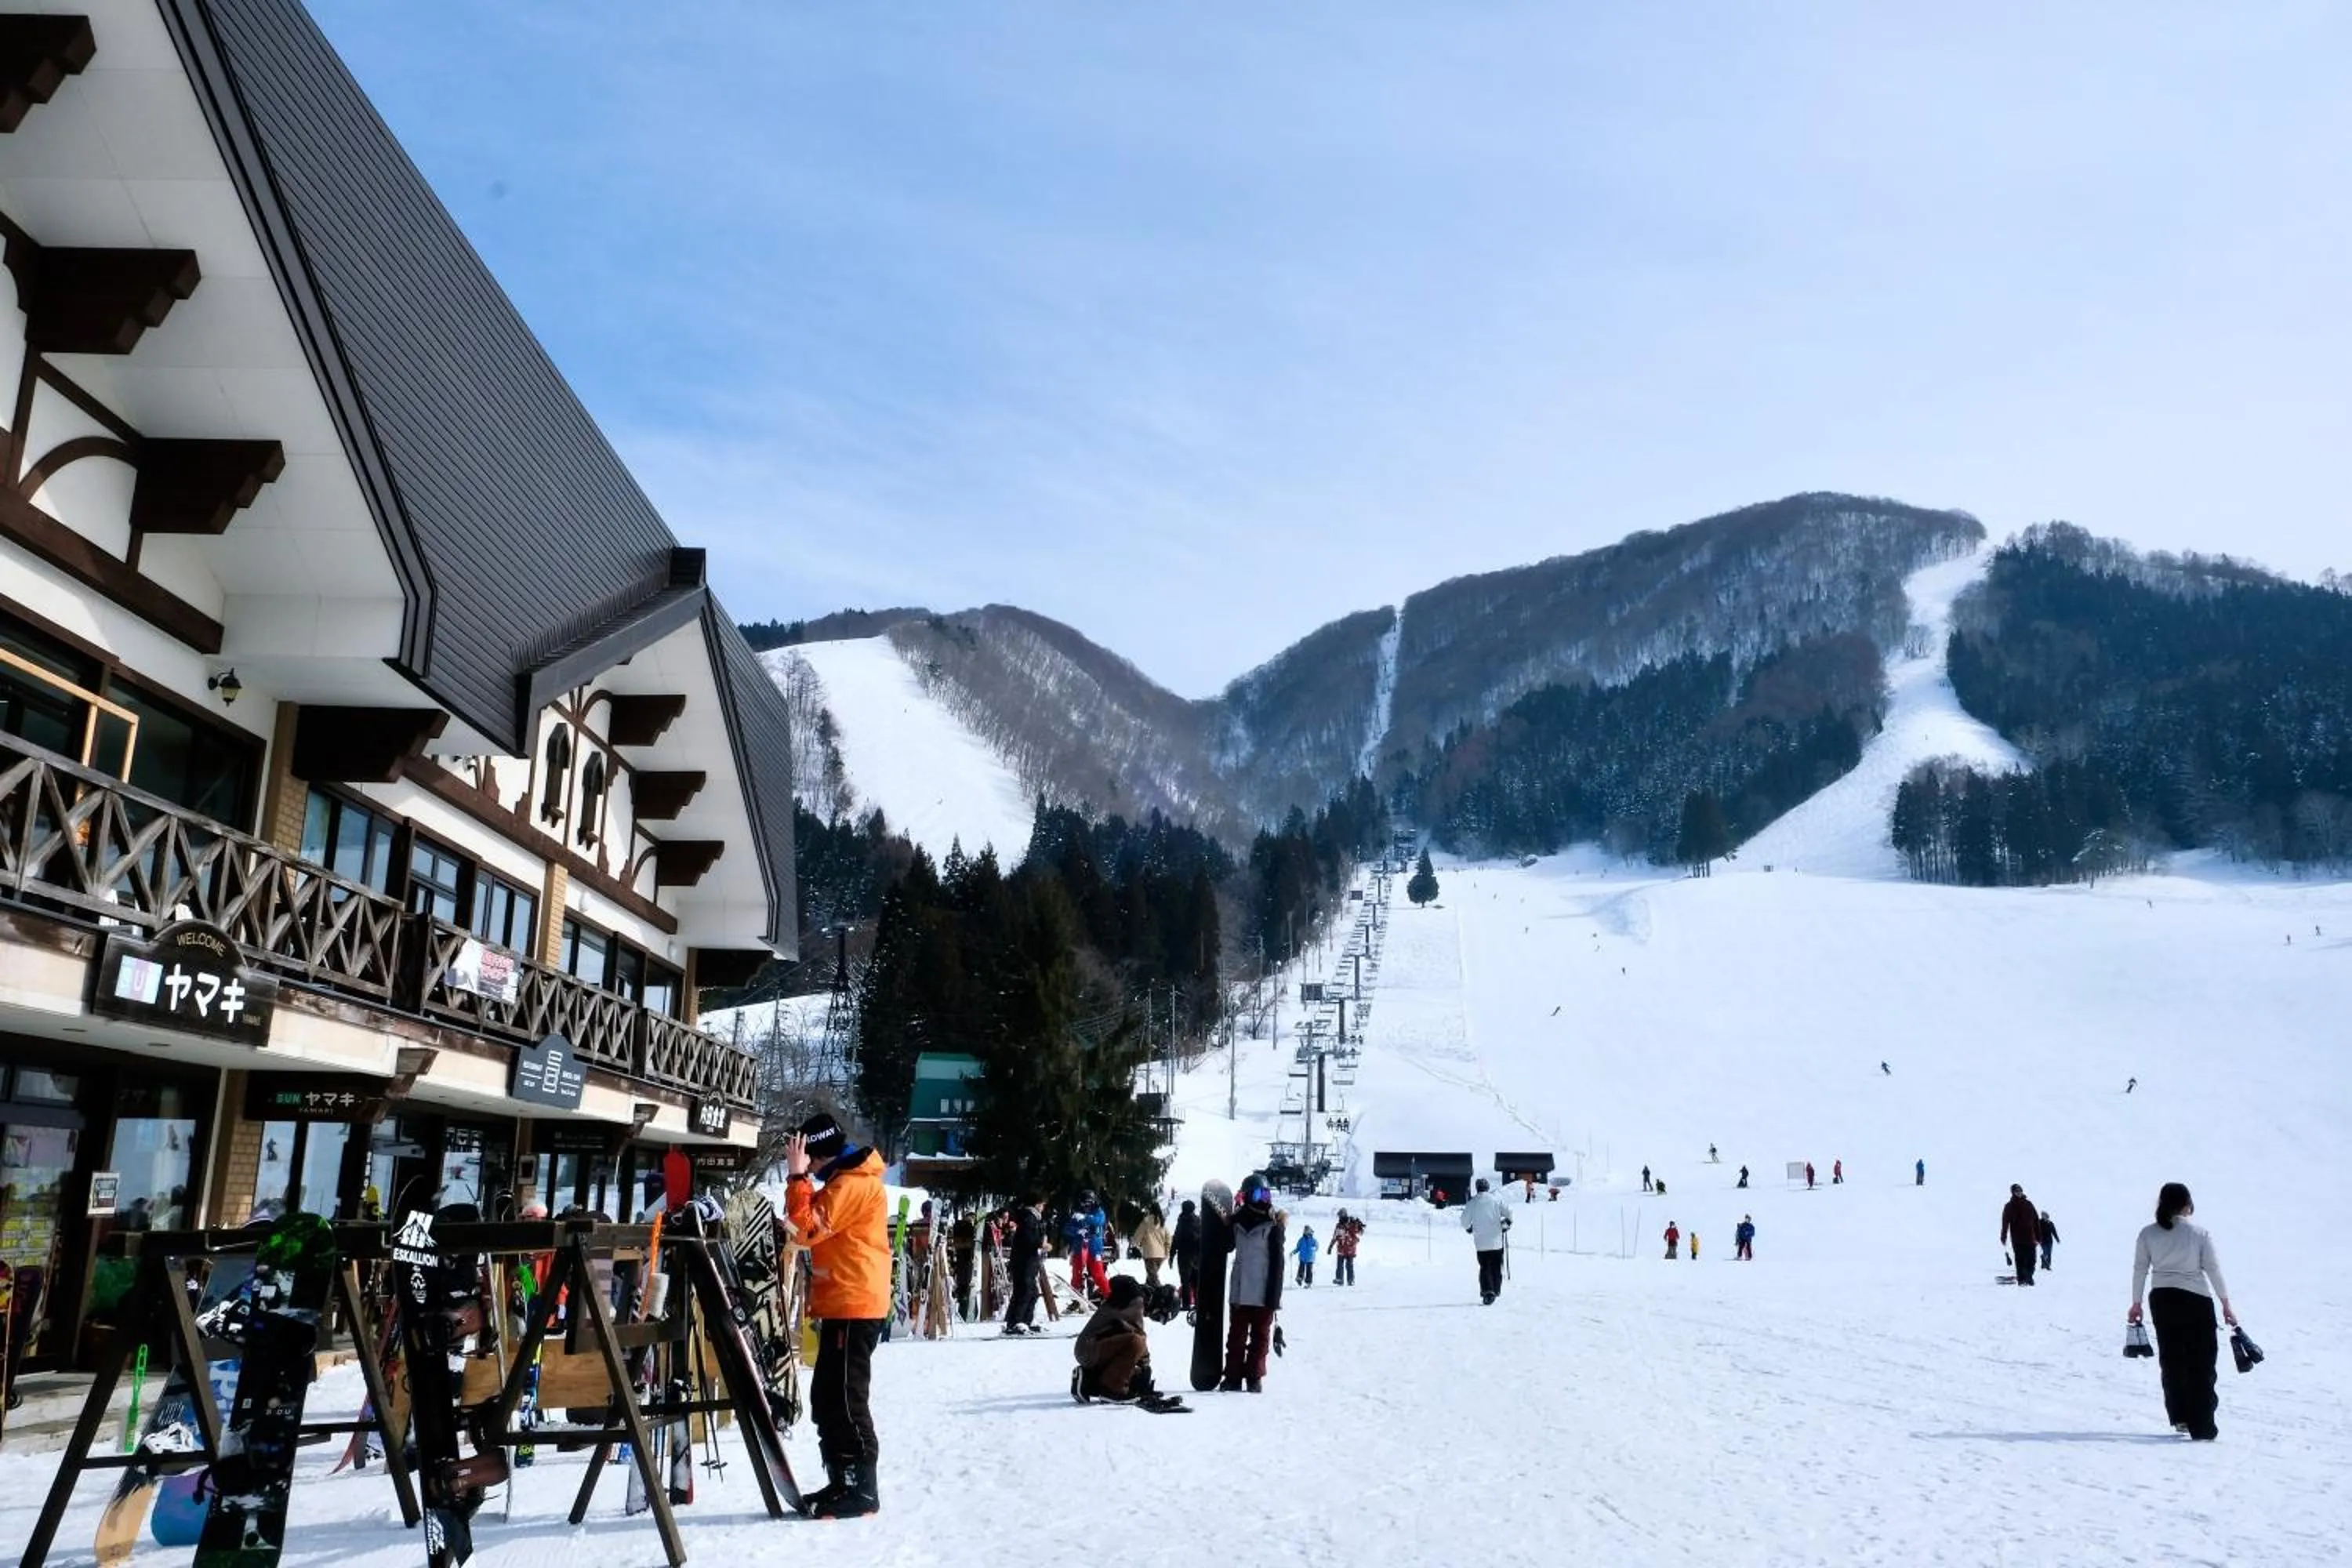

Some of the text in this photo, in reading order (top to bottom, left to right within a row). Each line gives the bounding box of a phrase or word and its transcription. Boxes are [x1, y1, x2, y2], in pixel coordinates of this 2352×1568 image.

[177, 932, 227, 957] WELCOME
[165, 963, 245, 1023] ヤマキ
[276, 1091, 354, 1107] SUN ヤマキ
[393, 1247, 439, 1268] ESKALLION
